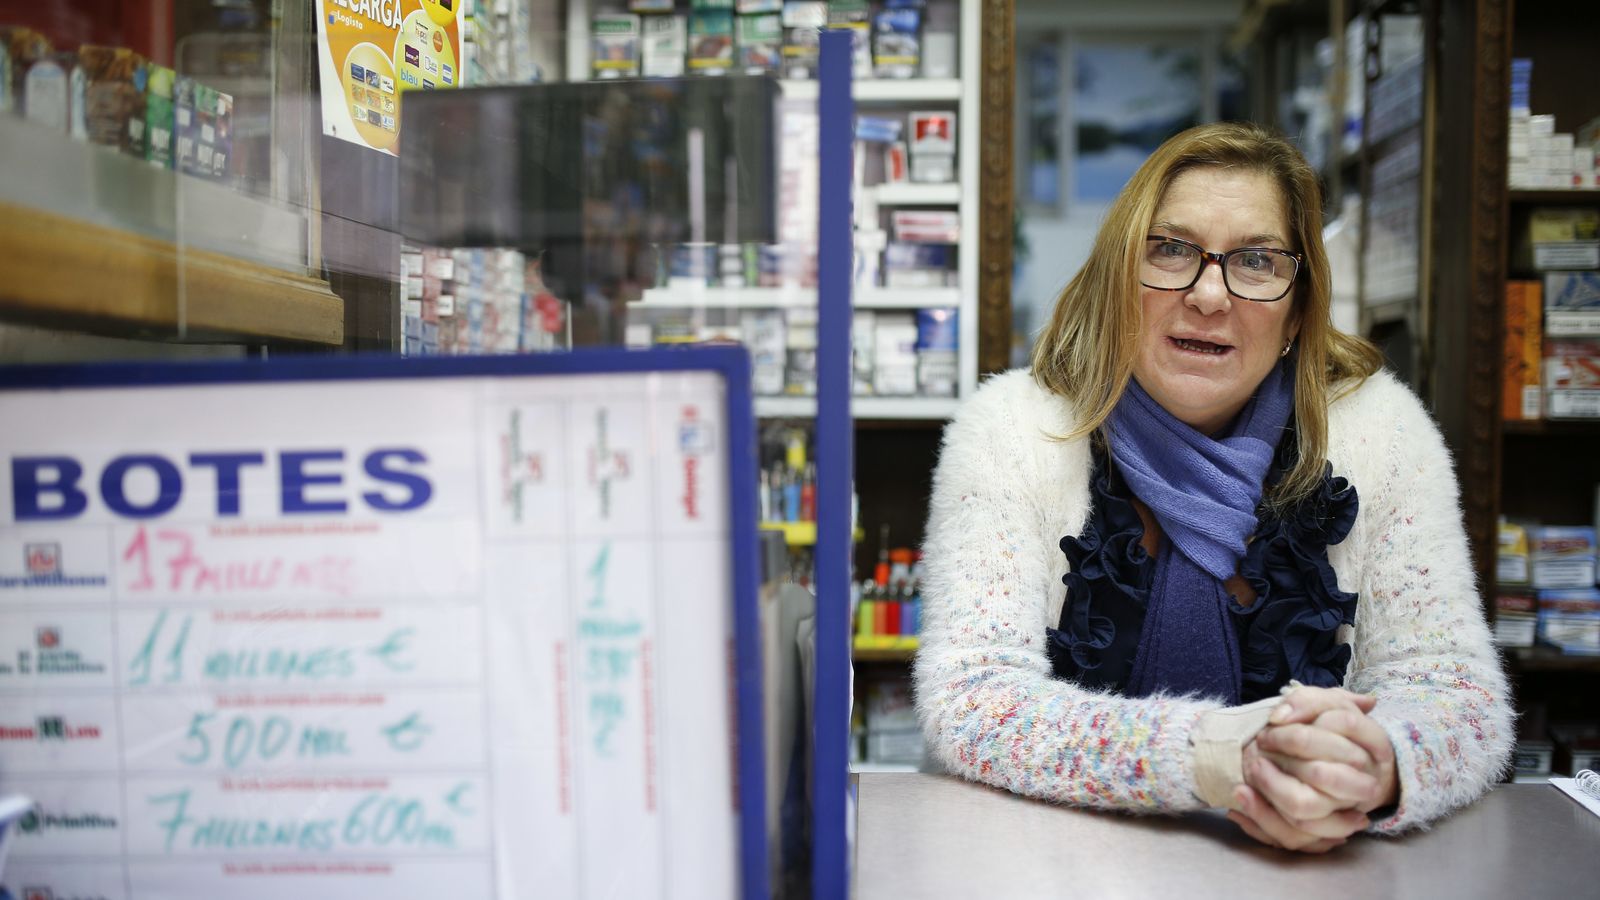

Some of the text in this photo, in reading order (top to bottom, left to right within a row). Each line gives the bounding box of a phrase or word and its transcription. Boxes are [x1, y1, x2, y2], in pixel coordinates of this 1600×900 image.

[337, 10, 363, 30] Logista
[401, 68, 418, 86] blau
[10, 447, 435, 523] BOTES
[122, 523, 195, 592] 17
[128, 608, 193, 686] 11
[177, 711, 293, 768] 500
[149, 790, 193, 854] 7
[342, 794, 424, 847] 600
